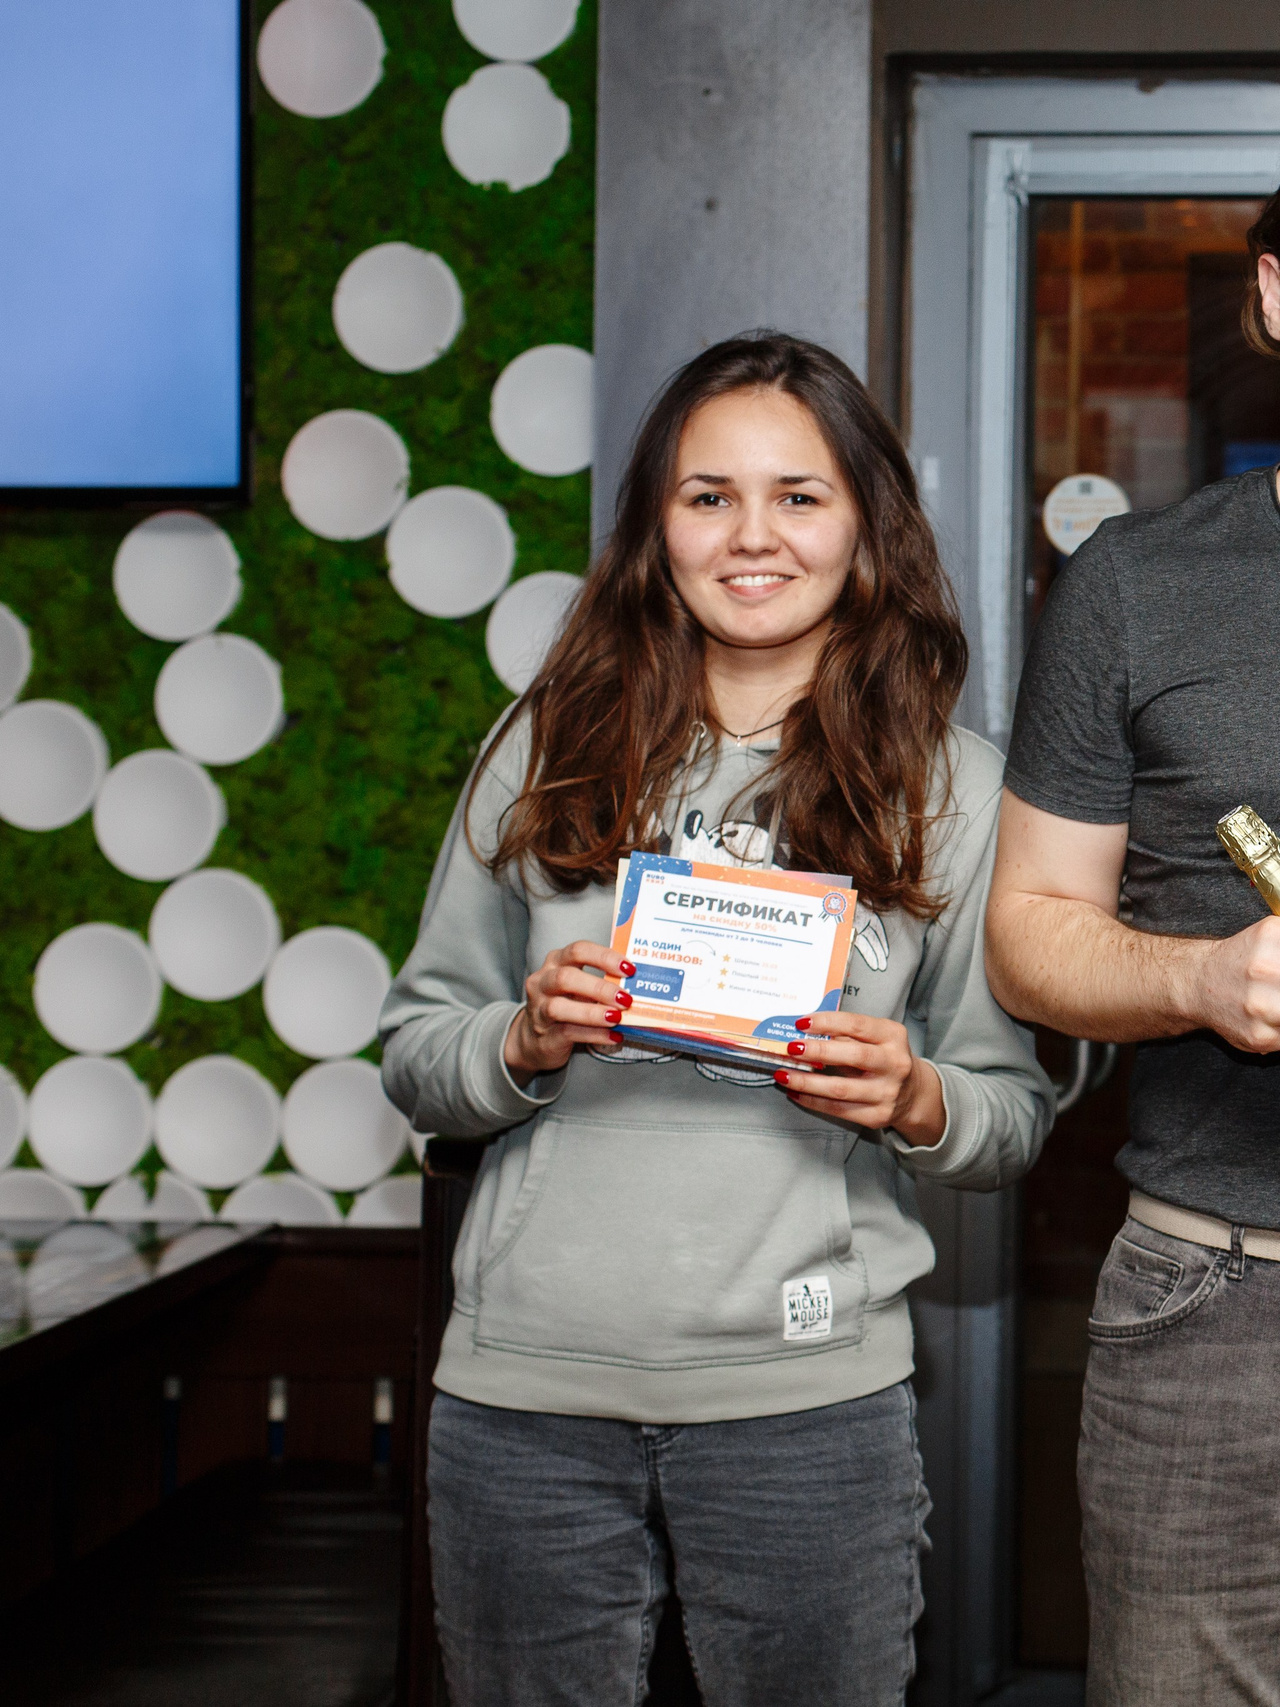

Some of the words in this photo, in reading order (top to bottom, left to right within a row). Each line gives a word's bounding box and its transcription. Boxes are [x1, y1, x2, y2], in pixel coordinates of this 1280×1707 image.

[663, 890, 813, 928] СЕРТИФИКАТ
[693, 913, 706, 921] на
[709, 915, 752, 930] скидку
[754, 921, 777, 932] 50%
[634, 938, 649, 946] НА
[651, 940, 682, 951] ОДИН
[632, 947, 648, 957] ИЗ
[651, 950, 703, 965] КВИЗОВ:
[843, 983, 860, 997] EY
[788, 1295, 829, 1311] MICKEY
[789, 1307, 828, 1323] MOUSE
